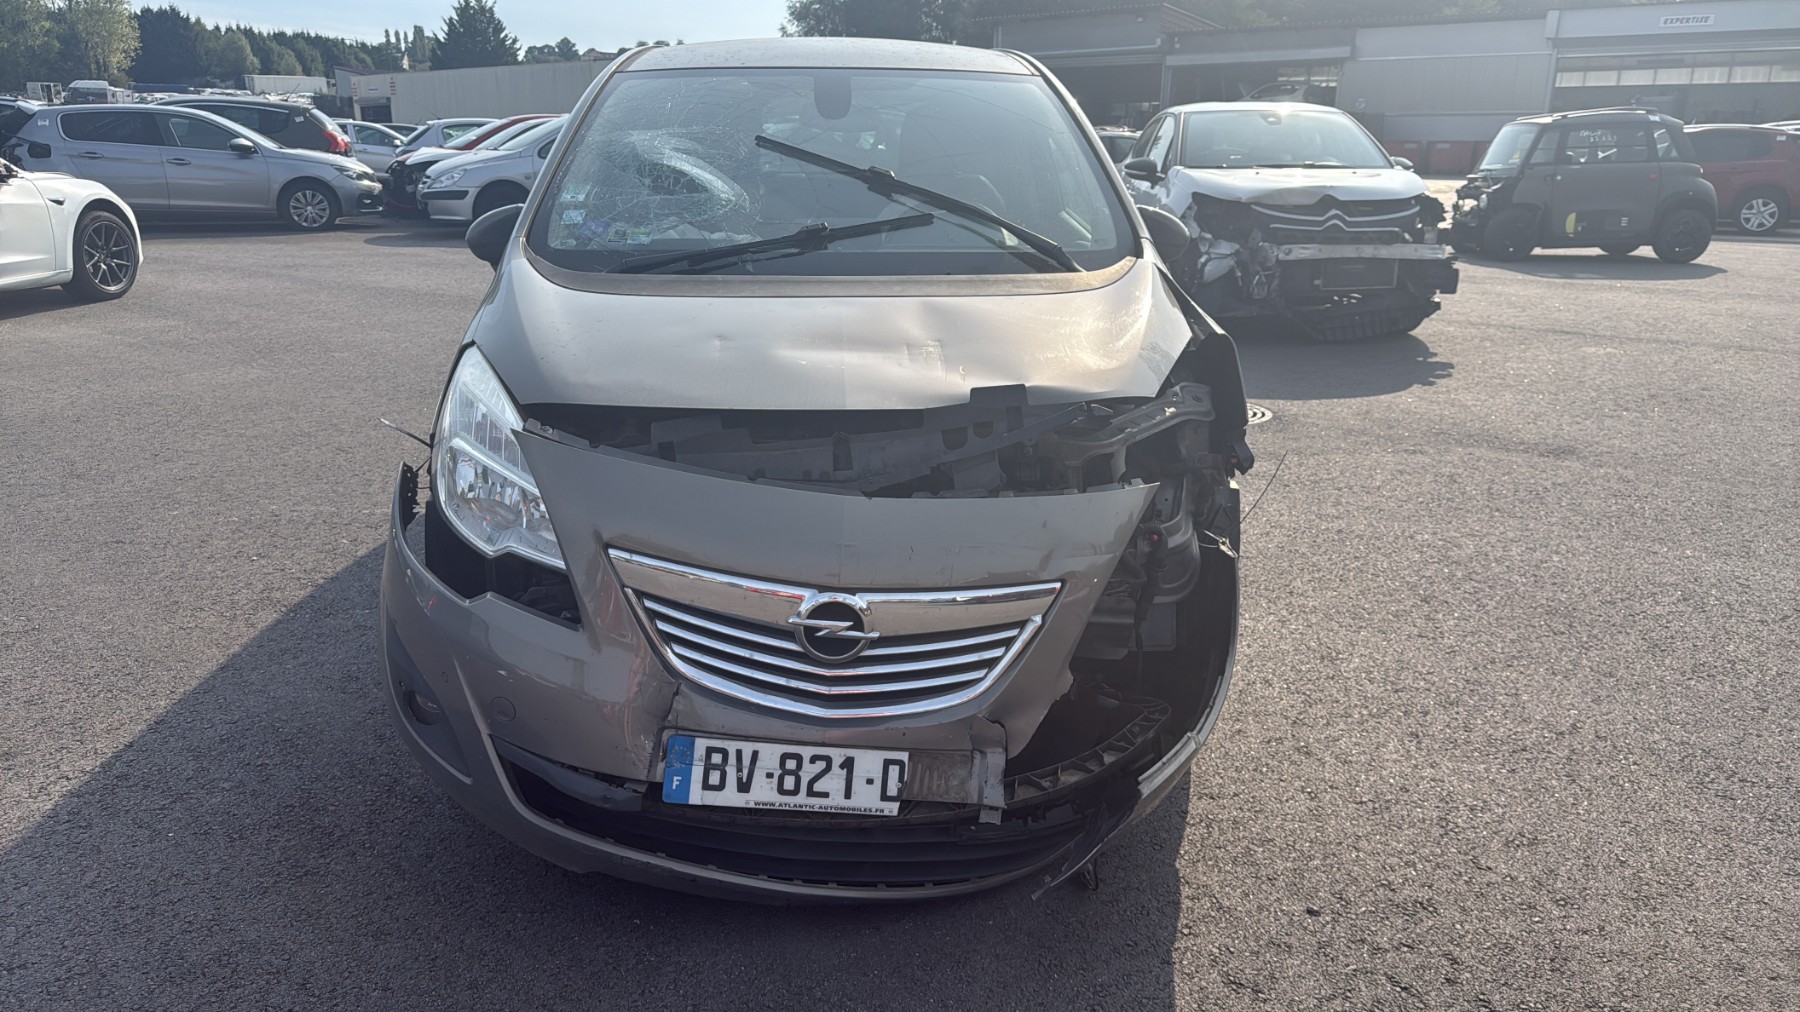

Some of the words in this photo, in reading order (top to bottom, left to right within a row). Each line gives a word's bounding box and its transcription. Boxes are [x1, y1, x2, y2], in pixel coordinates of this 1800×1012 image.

[1663, 16, 1711, 25] EXPERTISE
[671, 776, 682, 790] F
[753, 801, 886, 814] WWW.ATLANTIC-AUTOMOBILES.FR
